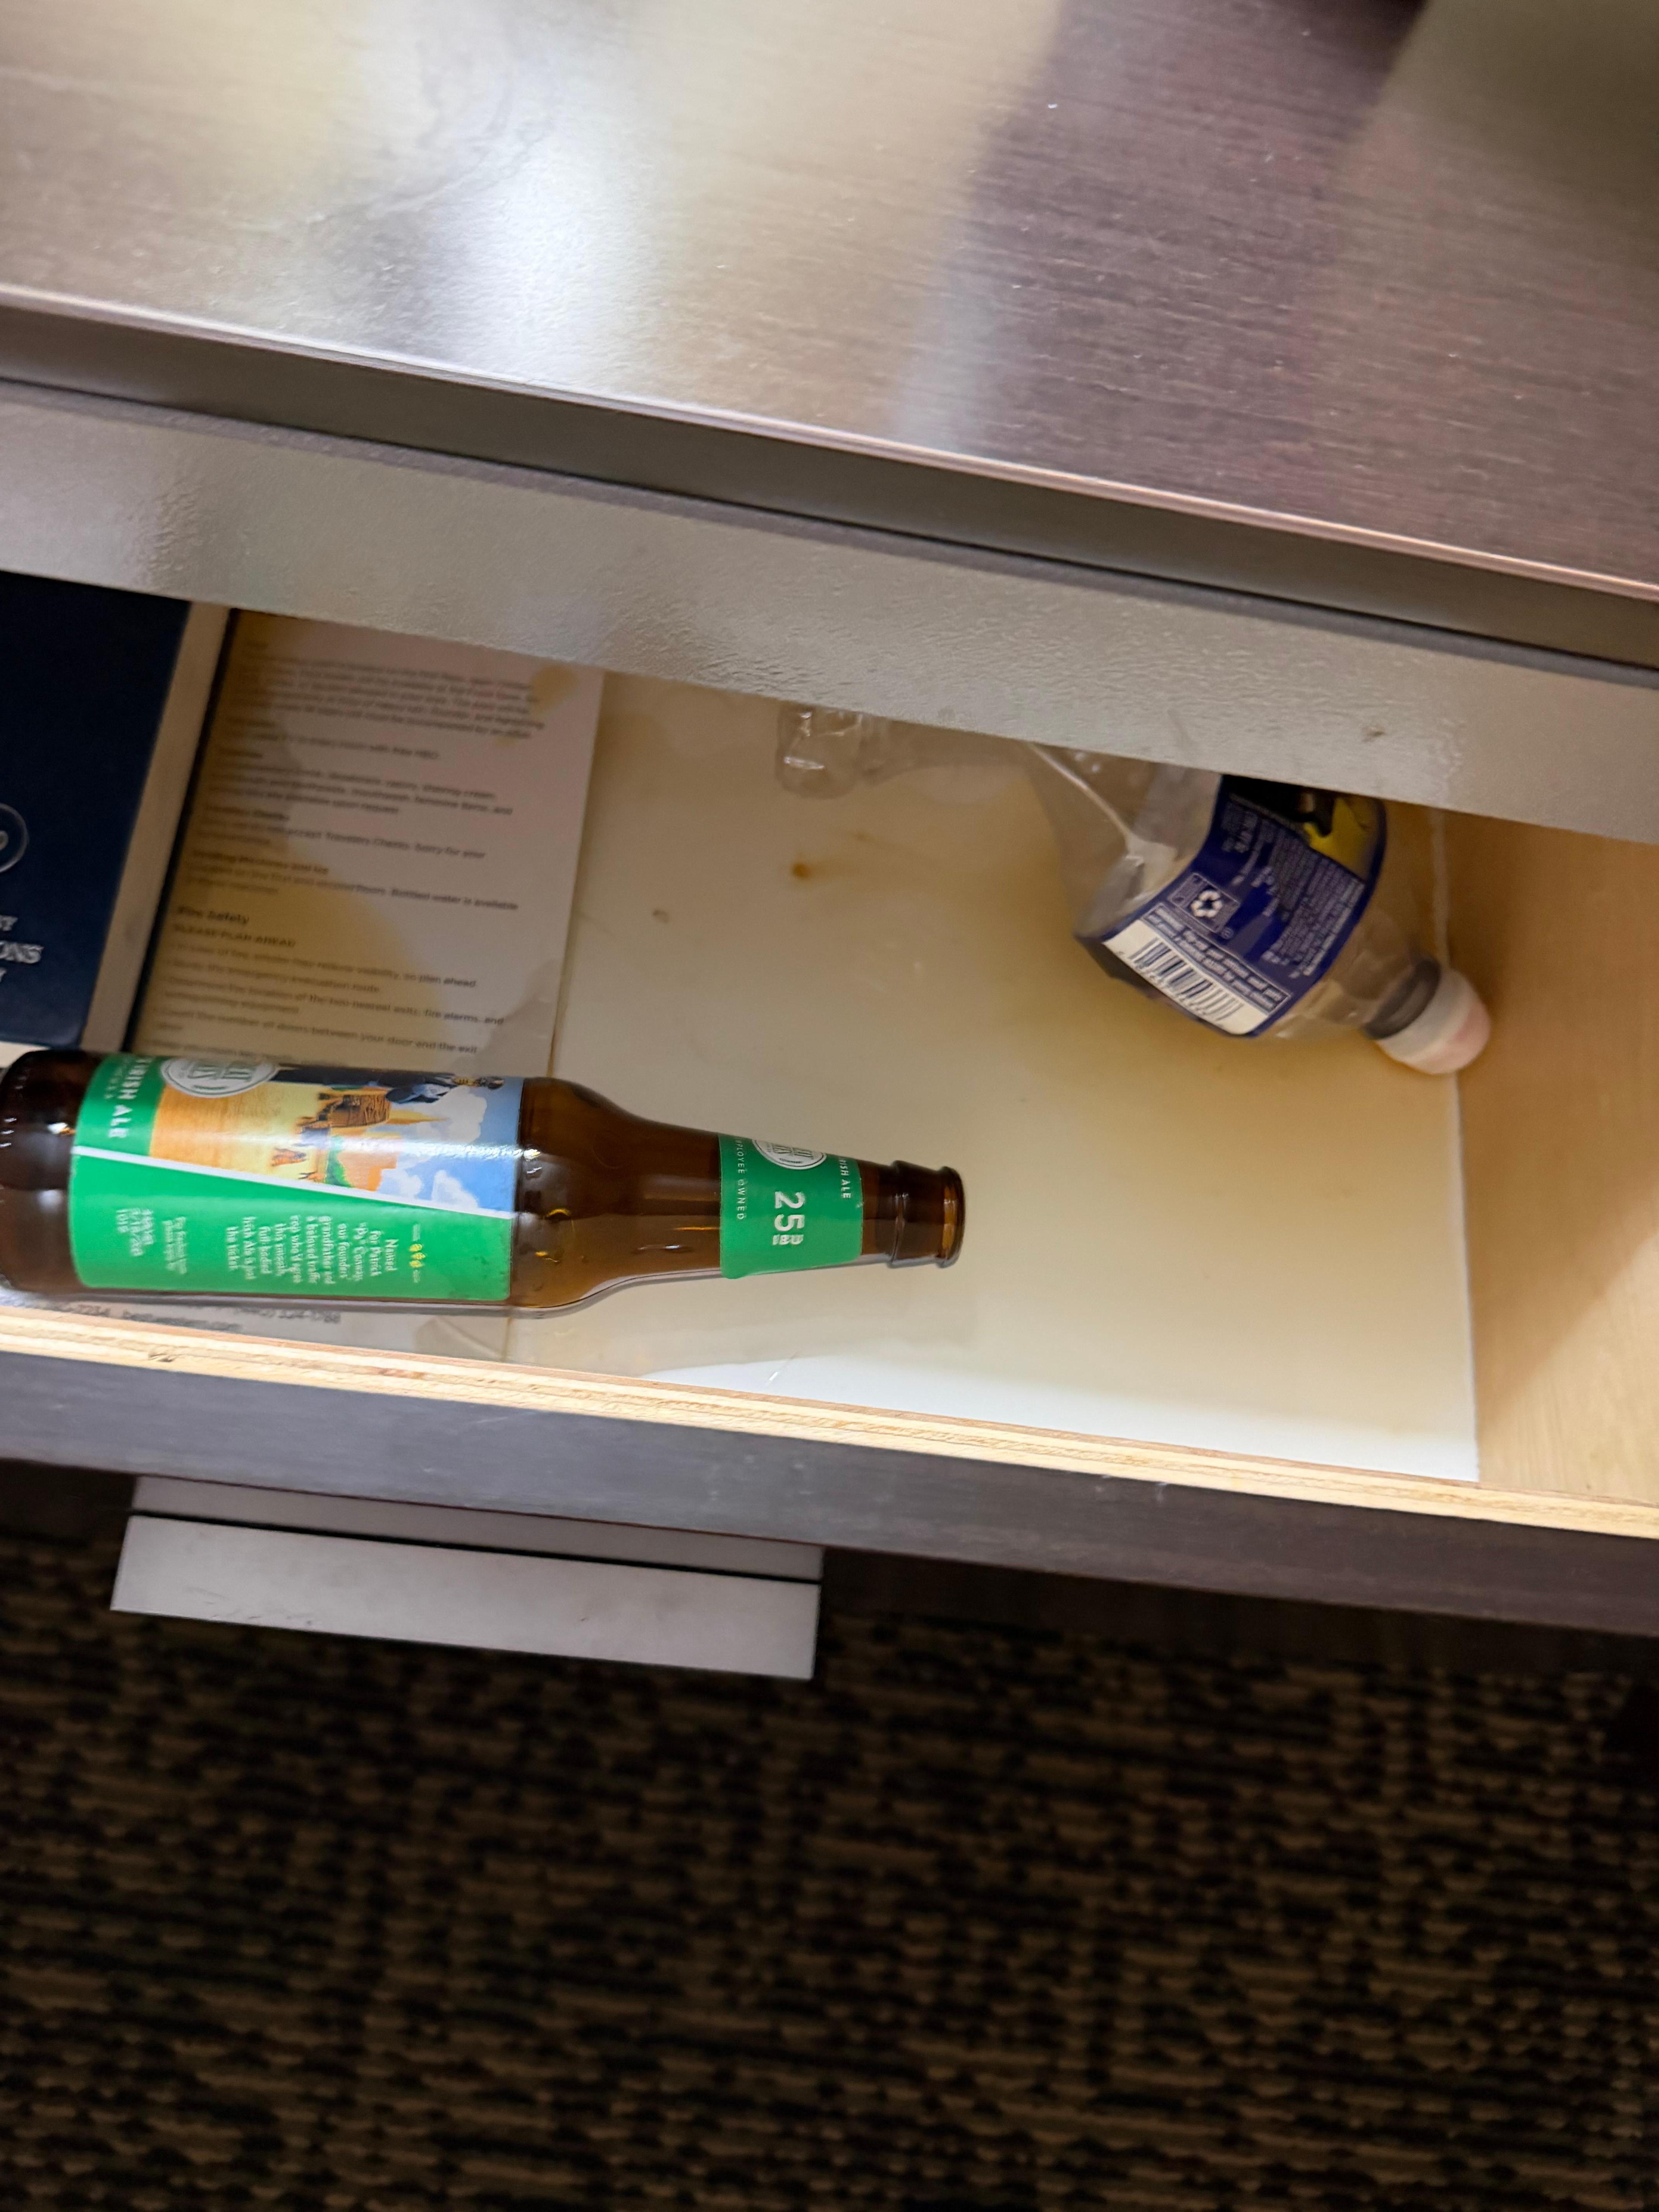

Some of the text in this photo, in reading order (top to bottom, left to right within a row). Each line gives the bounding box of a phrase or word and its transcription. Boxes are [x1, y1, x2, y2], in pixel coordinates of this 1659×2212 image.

[108, 1104, 133, 1139] ALE
[736, 1139, 746, 1219] MPLOYEE OWNED
[841, 1179, 851, 1198] ALE
[774, 1190, 805, 1231] 25
[226, 1226, 239, 1243] the
[274, 1223, 286, 1241] this
[306, 1224, 319, 1258] beloved
[318, 1216, 334, 1268] grandfather
[338, 1223, 347, 1239] our
[369, 1247, 382, 1276] Patrick
